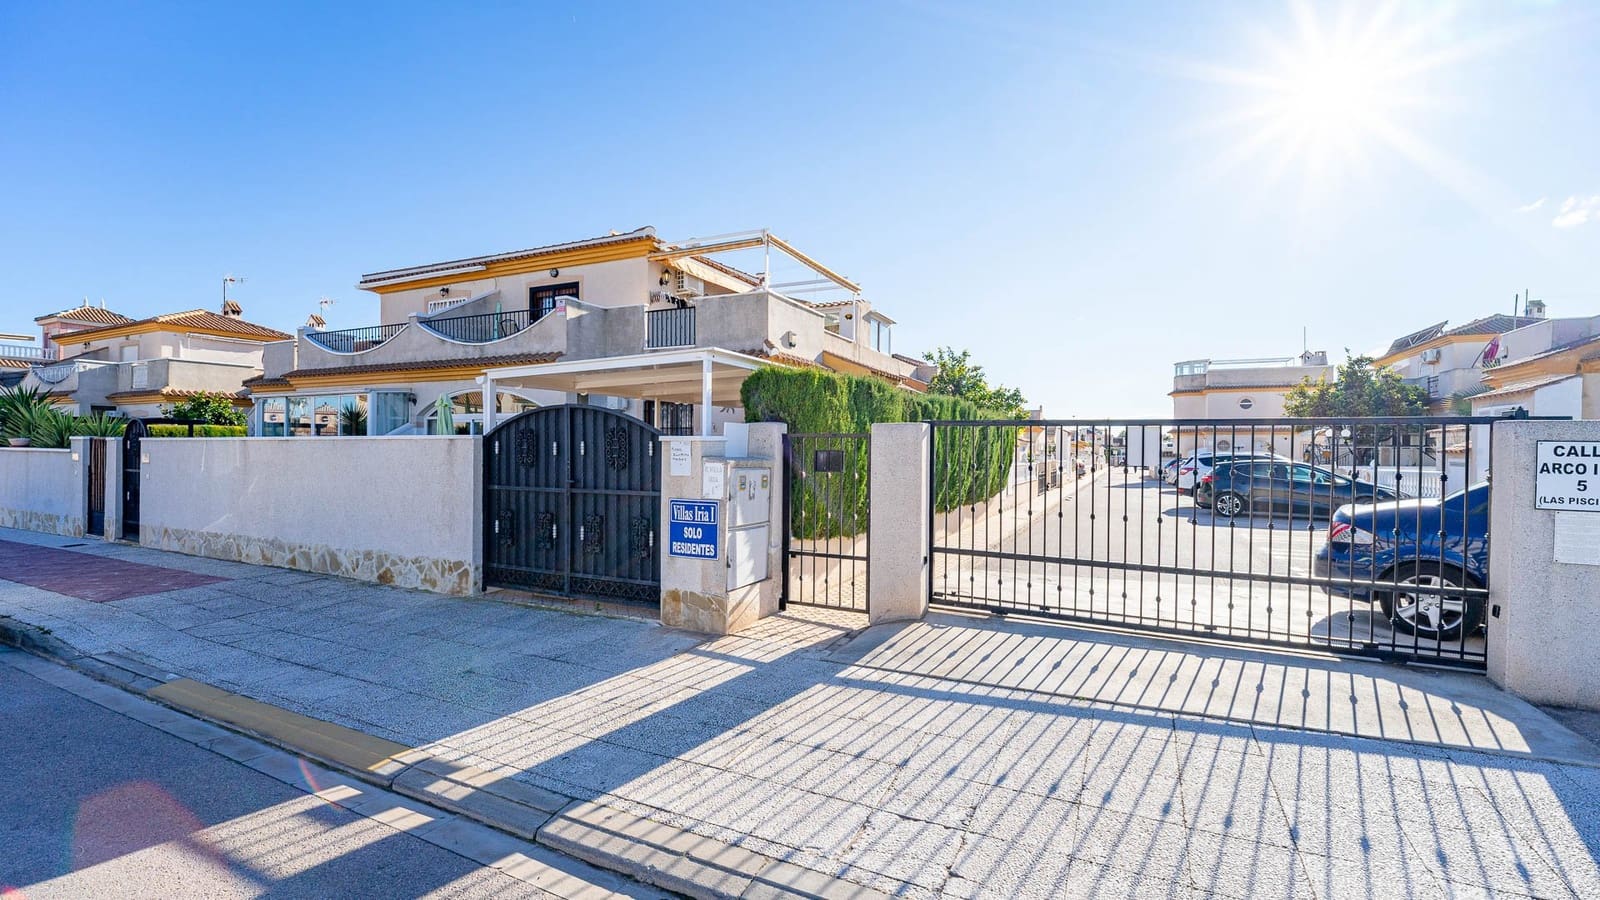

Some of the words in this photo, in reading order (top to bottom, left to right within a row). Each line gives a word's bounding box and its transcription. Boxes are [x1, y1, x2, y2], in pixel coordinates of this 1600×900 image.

[1553, 446, 1600, 458] CALL
[1539, 462, 1587, 475] ARCO
[1577, 480, 1588, 492] 5
[1539, 496, 1565, 505] (LAS
[673, 504, 694, 521] Villas
[694, 505, 709, 522] Iria
[710, 506, 715, 522] I
[683, 526, 703, 540] SOLO
[672, 541, 715, 557] RESIDENTES
